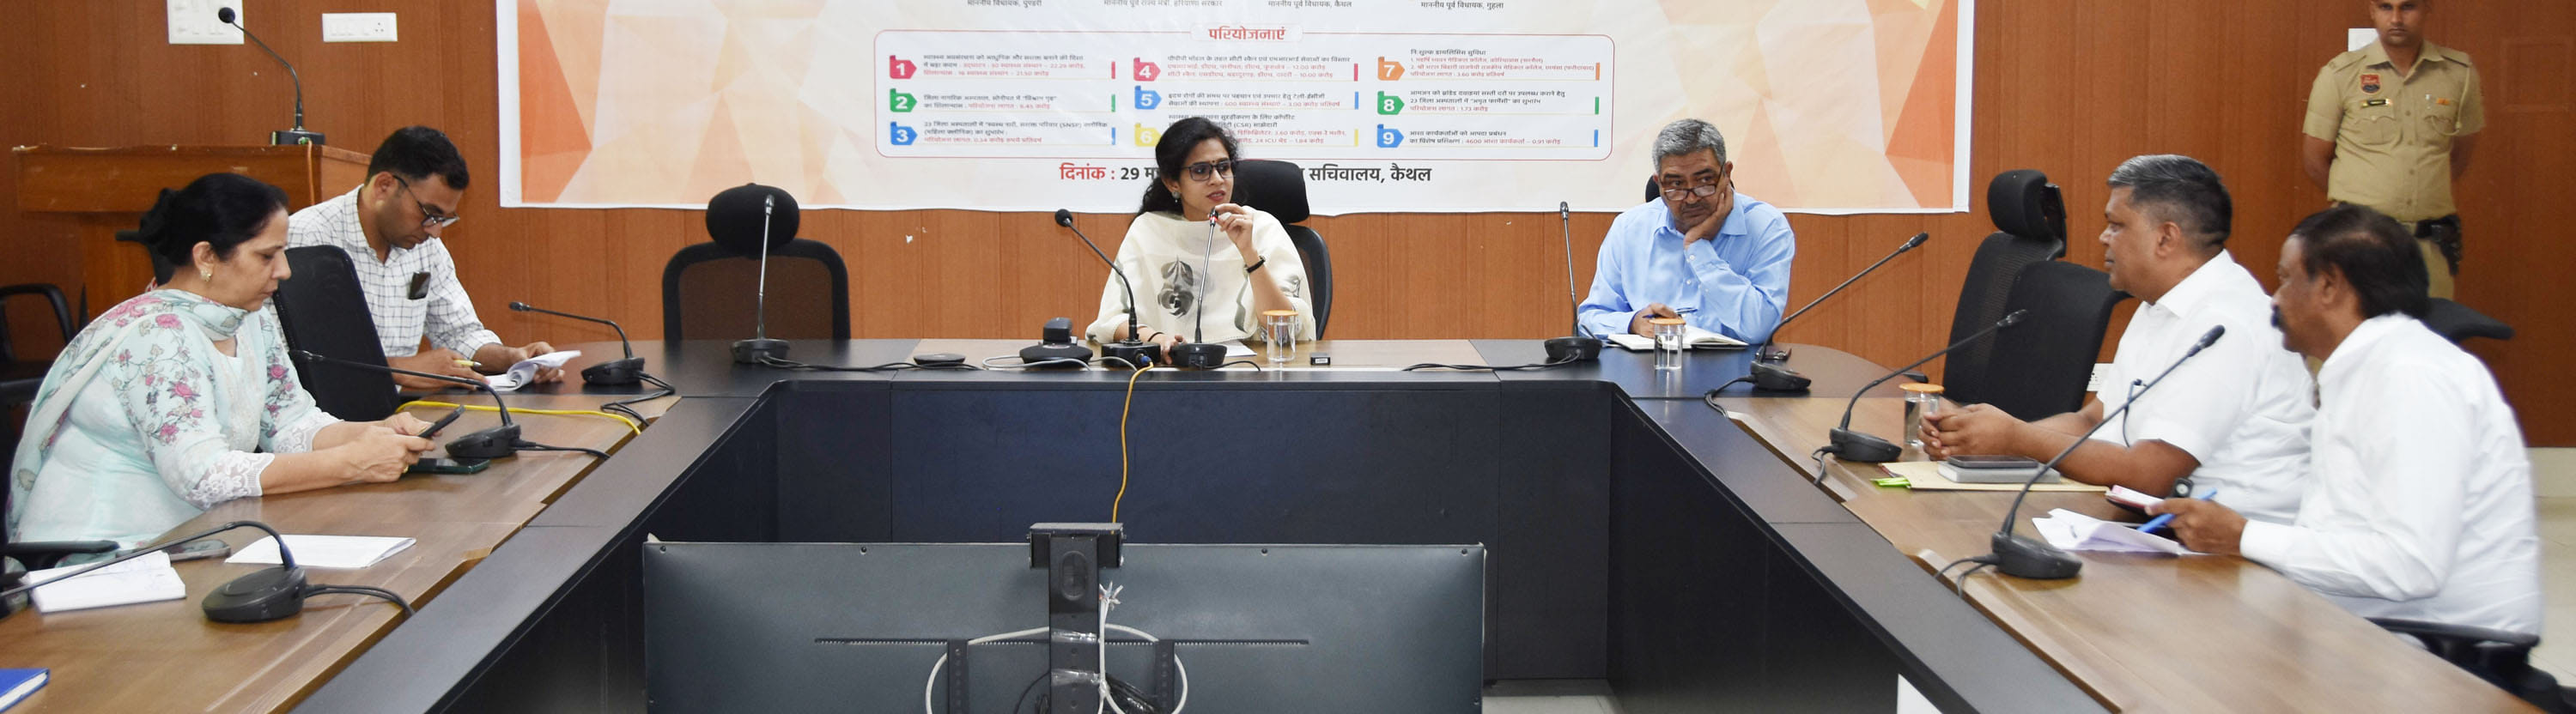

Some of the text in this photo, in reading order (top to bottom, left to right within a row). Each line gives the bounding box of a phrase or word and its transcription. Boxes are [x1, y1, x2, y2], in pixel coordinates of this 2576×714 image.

[1446, 1, 1455, 10] पूर्व
[1487, 2, 1504, 10] गुहला
[1208, 25, 1285, 39] परियोजनाएं
[896, 63, 905, 76] 1
[1139, 65, 1151, 78] 4
[1384, 65, 1394, 77] 7
[896, 96, 908, 110] 2
[1140, 94, 1152, 106] 5
[1384, 99, 1394, 112] 8
[896, 130, 908, 142] 3
[1140, 131, 1152, 144] 6
[1383, 132, 1394, 144] 9
[1060, 162, 1106, 179] दिनांक
[1121, 167, 1139, 180] 29
[1309, 163, 1385, 183] सचिवालय,
[1390, 162, 1432, 181] कैथल
